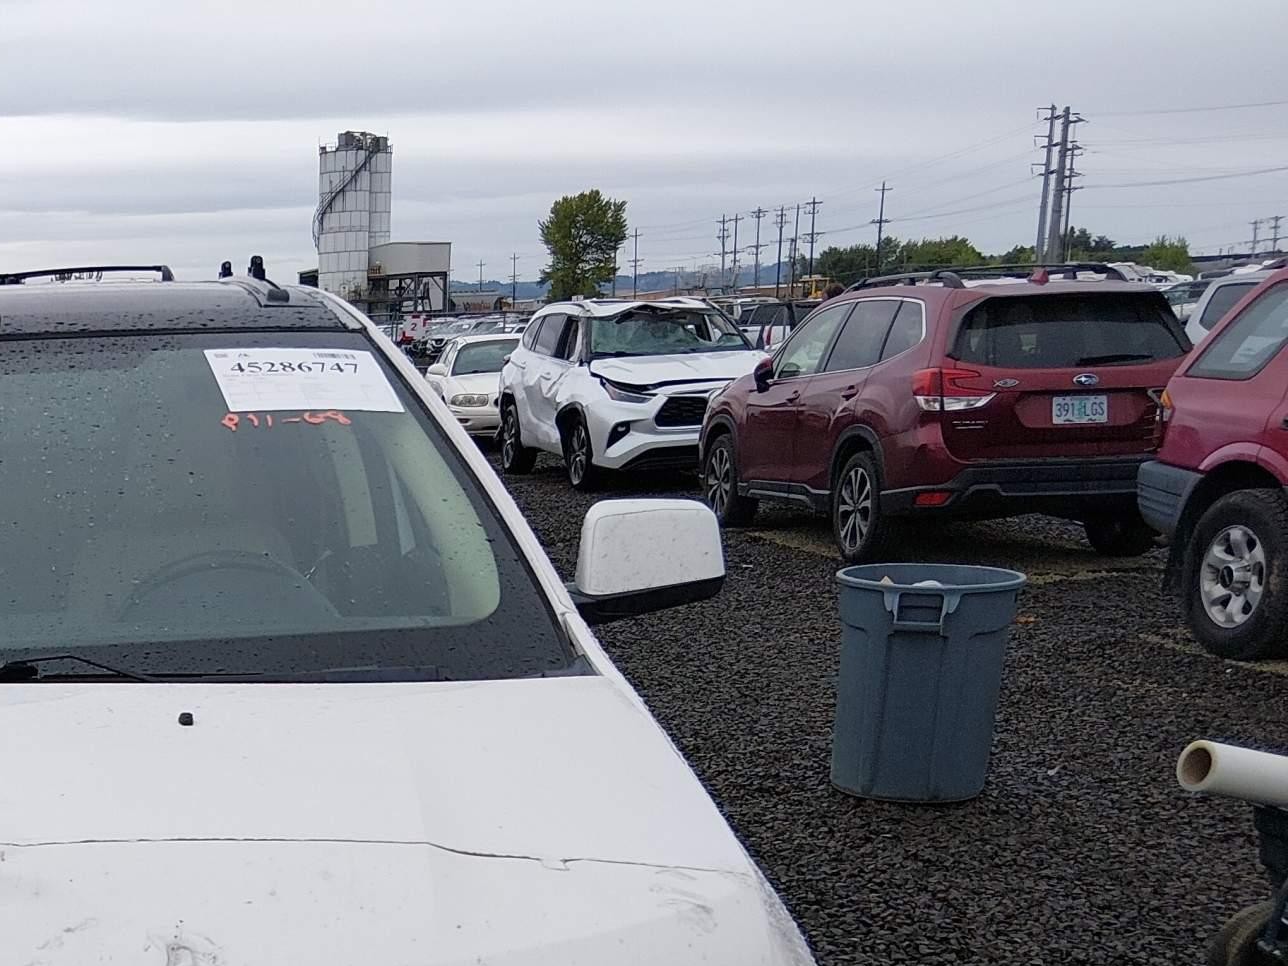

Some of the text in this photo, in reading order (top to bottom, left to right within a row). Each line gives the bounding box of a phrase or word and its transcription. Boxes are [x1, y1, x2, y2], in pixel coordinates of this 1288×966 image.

[230, 361, 359, 374] 45286747
[1055, 401, 1105, 418] 391 LGS
